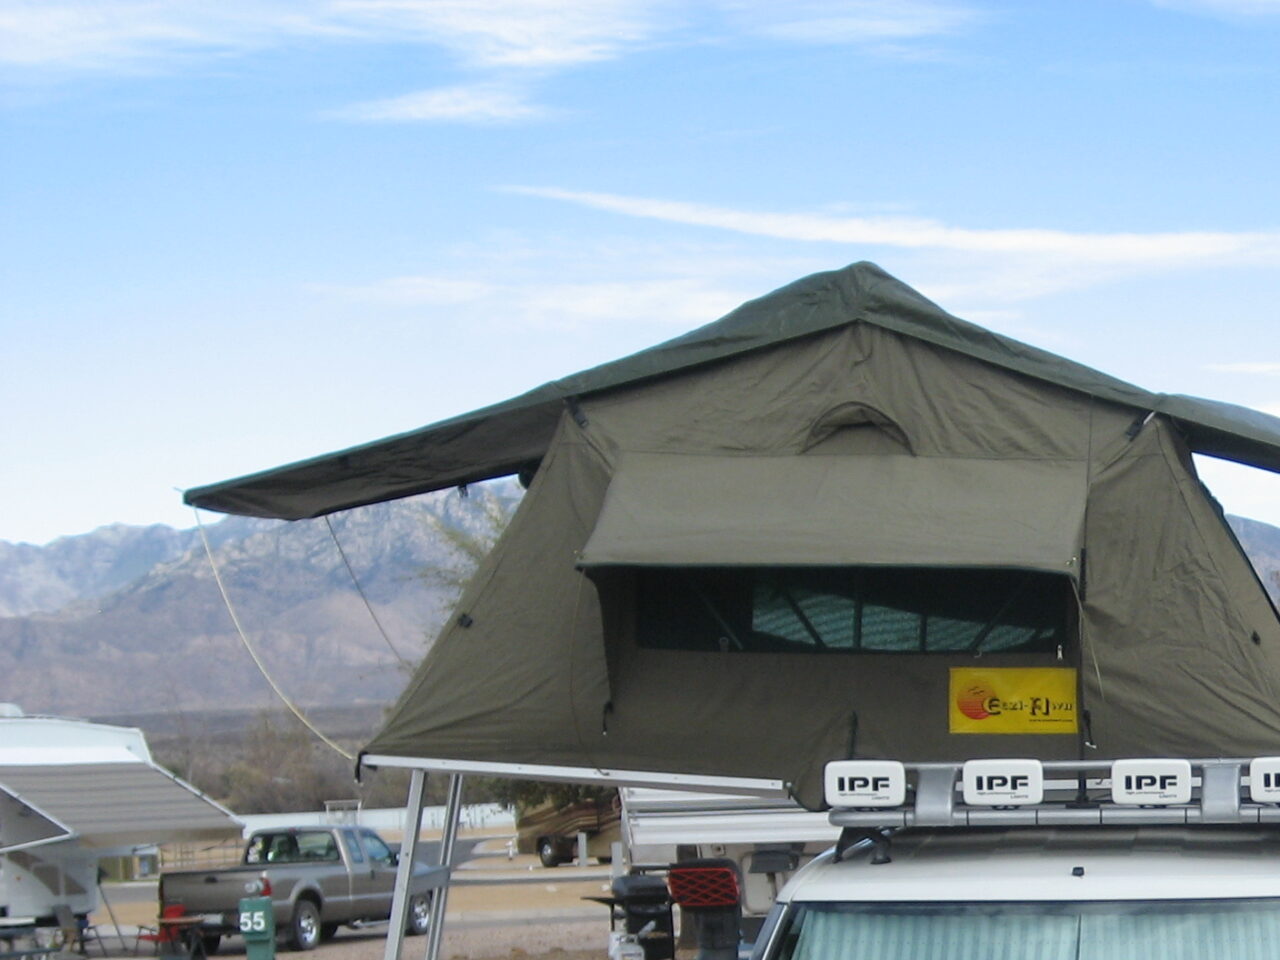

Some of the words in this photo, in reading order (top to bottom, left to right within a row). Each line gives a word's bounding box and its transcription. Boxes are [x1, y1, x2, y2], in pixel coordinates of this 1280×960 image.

[838, 776, 890, 791] IPF
[976, 775, 1029, 790] IPF
[1125, 775, 1178, 790] IPF
[240, 911, 265, 932] 55
